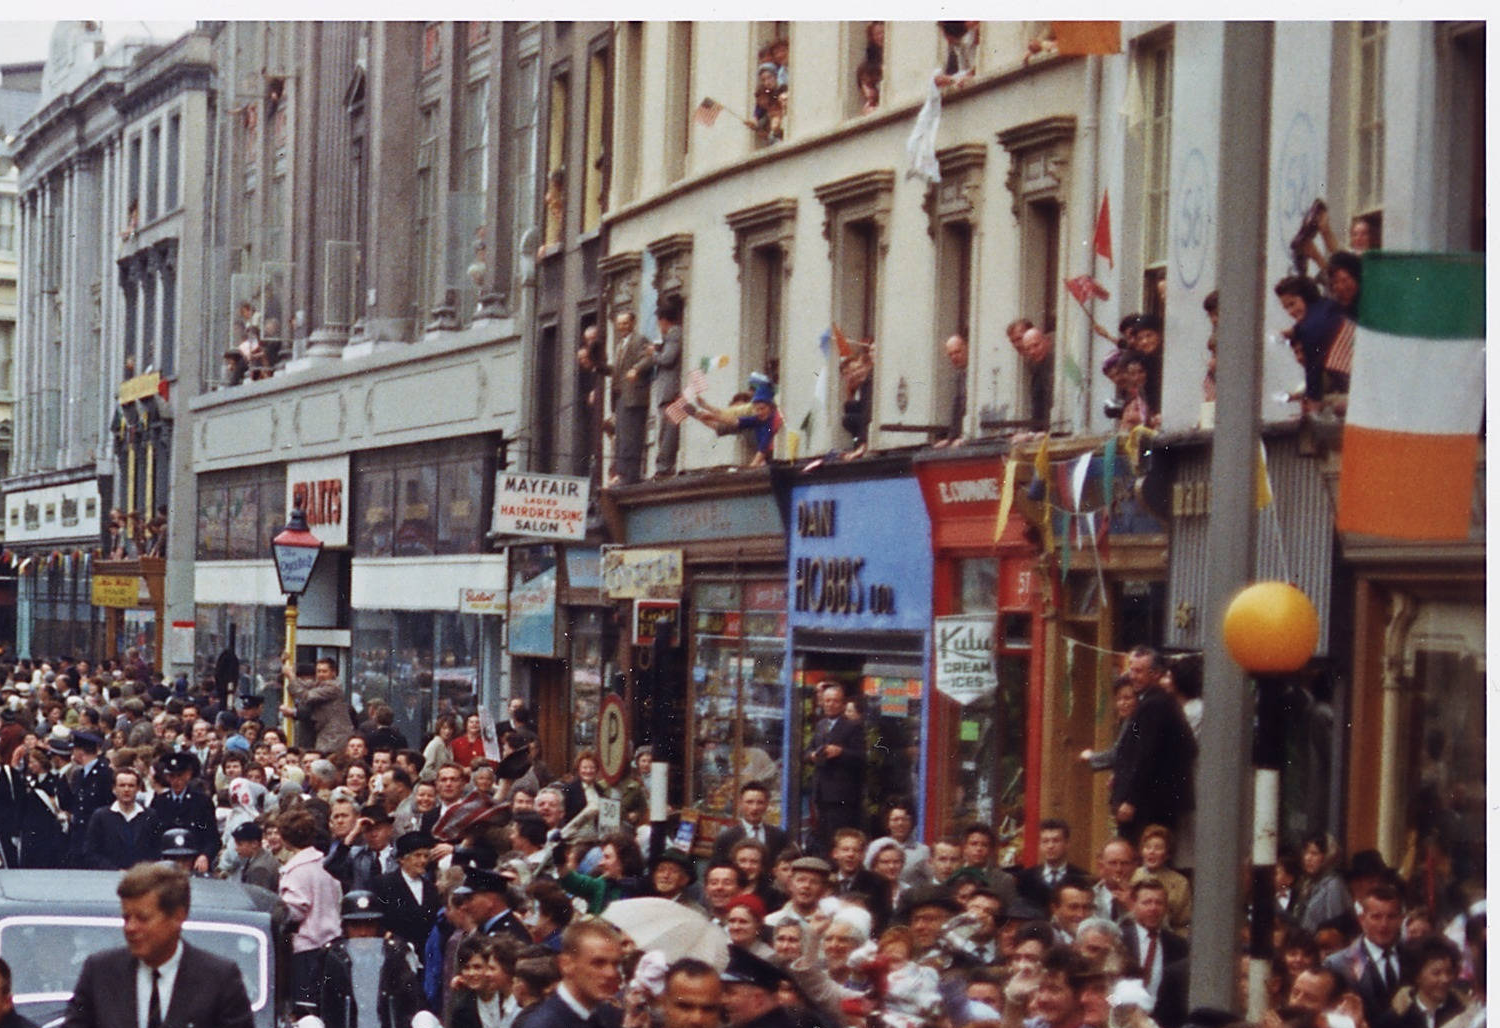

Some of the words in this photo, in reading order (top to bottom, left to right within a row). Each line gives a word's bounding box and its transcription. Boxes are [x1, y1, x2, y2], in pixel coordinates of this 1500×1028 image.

[504, 476, 580, 497] MAYFAIR
[501, 504, 584, 522] HAIRDRESSING
[515, 519, 559, 532] SALON
[796, 557, 866, 614] HOBBS
[943, 661, 993, 674] CREAM
[951, 676, 985, 688] ICES
[606, 710, 619, 768] P
